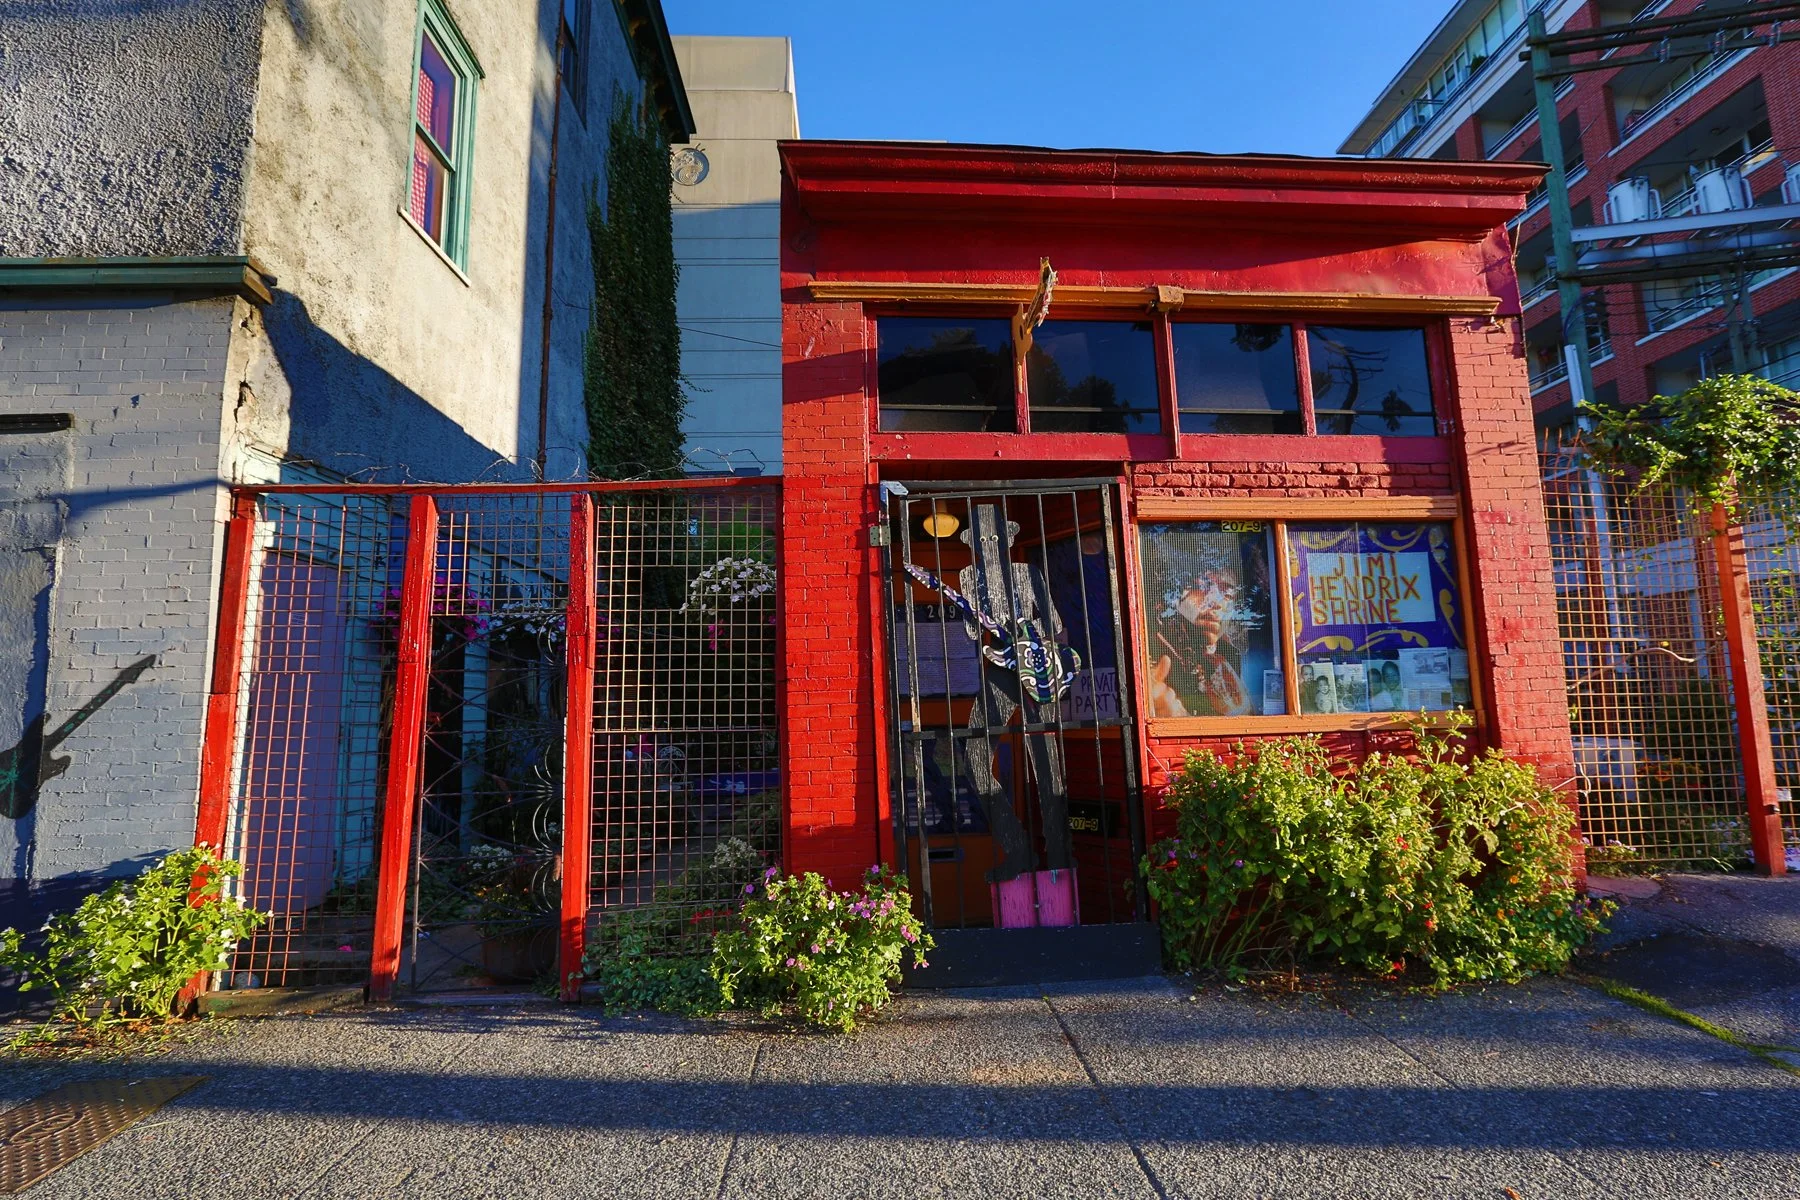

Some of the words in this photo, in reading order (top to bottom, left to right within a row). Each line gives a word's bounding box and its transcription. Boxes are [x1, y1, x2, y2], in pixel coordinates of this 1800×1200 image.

[1222, 520, 1261, 532] 207-9
[1333, 552, 1397, 577] JIMI
[1309, 575, 1420, 601] HENDRIX
[1313, 598, 1403, 625] SHRINE
[1075, 692, 1119, 713] PARTY
